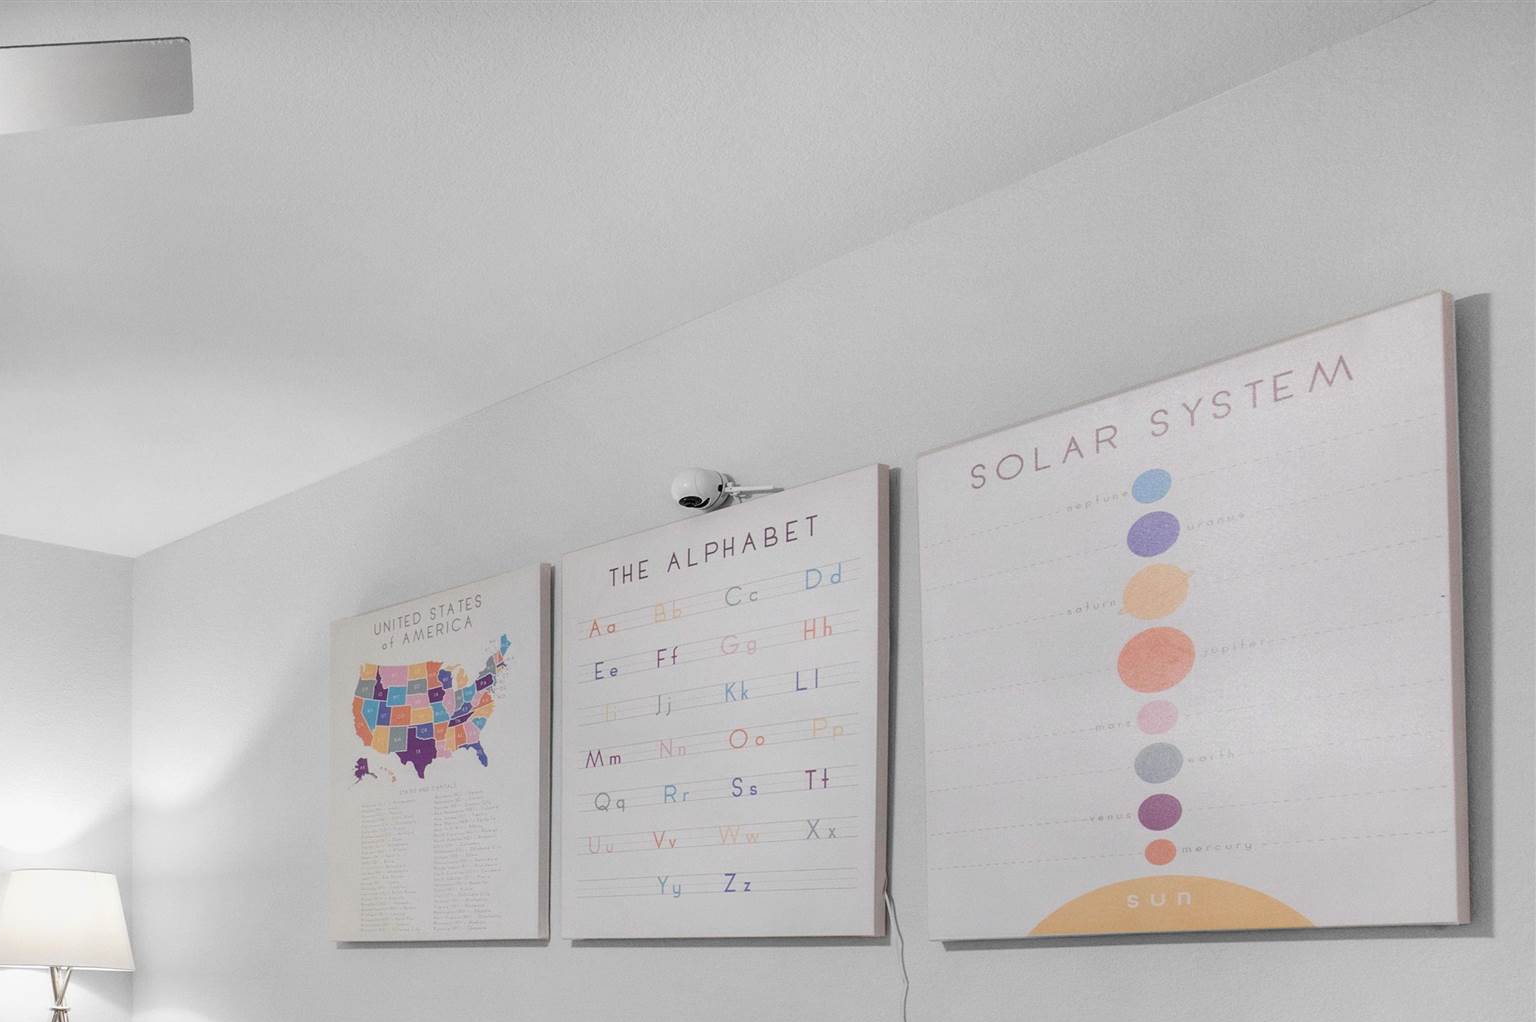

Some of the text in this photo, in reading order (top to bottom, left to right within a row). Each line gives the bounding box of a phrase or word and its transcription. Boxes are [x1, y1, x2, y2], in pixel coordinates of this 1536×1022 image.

[970, 354, 1353, 490] SOLAR SYSTEM
[609, 515, 818, 586] THE ALPHABET
[373, 594, 483, 636] UNITED STATES
[382, 615, 473, 650] of AMERICA
[1182, 842, 1253, 854] mercury
[1127, 891, 1192, 909] sun
